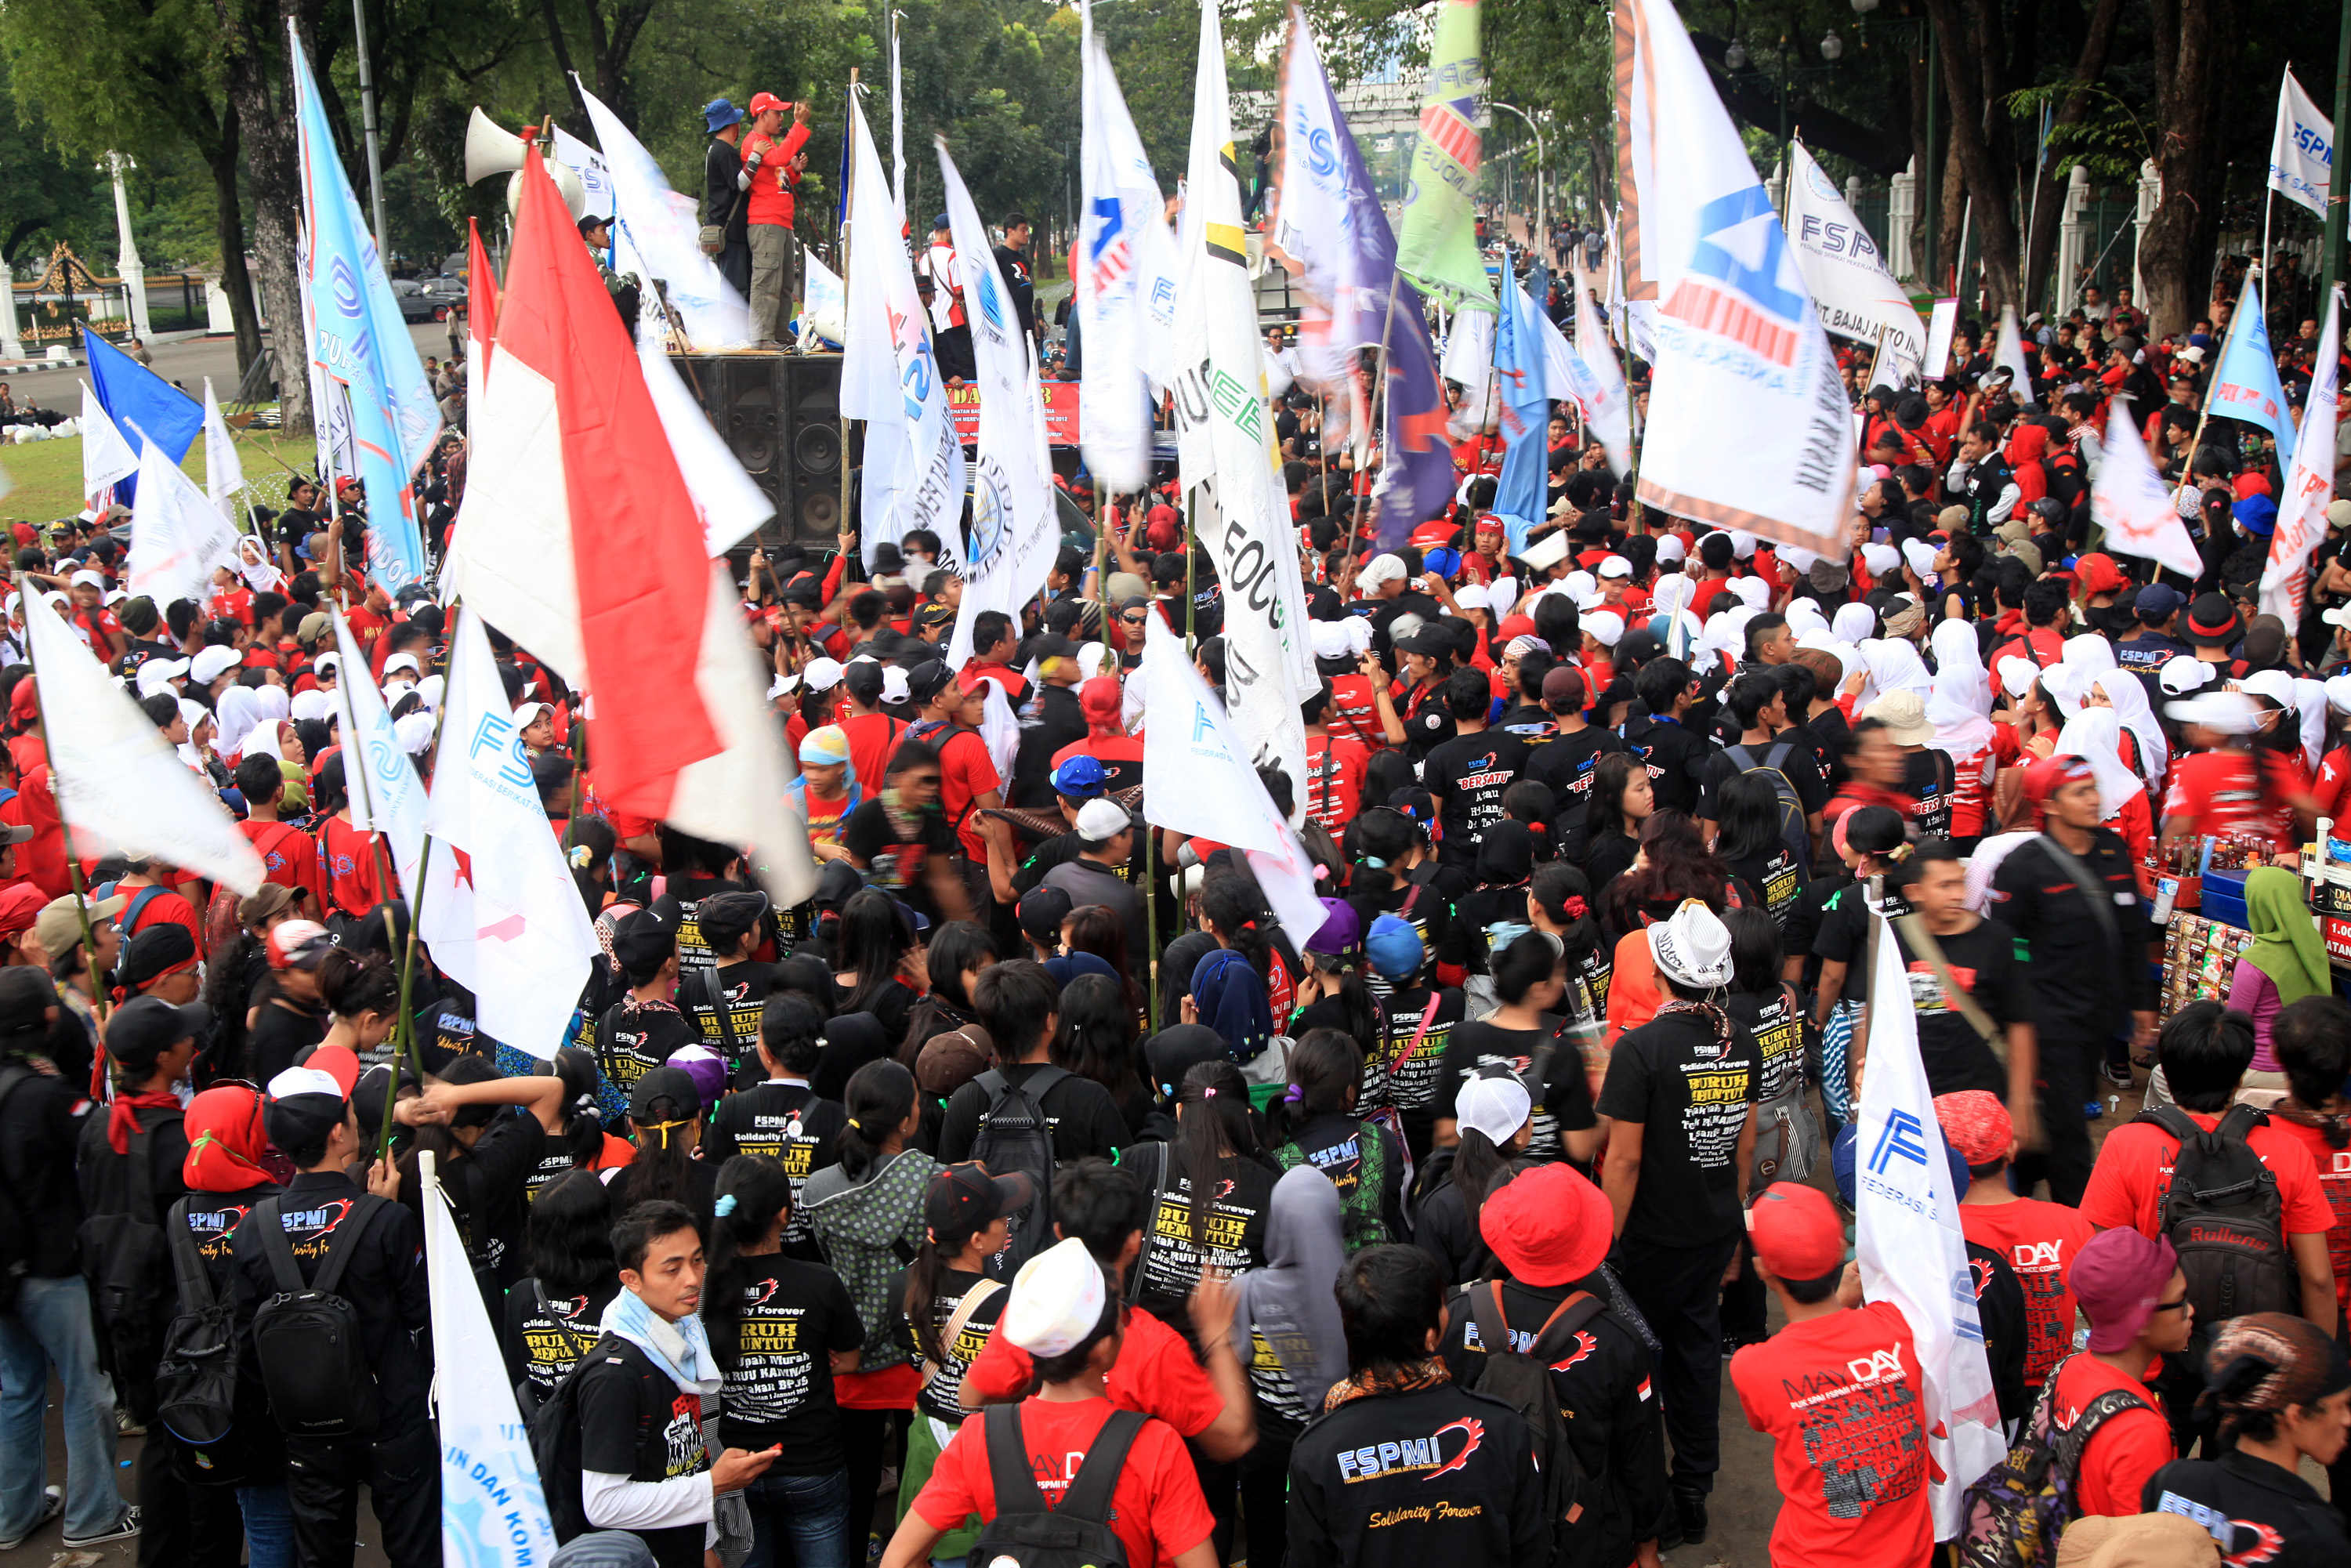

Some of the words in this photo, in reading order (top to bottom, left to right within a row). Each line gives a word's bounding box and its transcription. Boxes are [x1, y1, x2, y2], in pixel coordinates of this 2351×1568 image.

[1833, 311, 1868, 335] BAJAJ
[2121, 650, 2157, 661] FSPMI
[497, 784, 531, 808] SERIKAT
[1476, 790, 1499, 802] Atau
[1759, 1003, 1781, 1016] FSPMI
[1688, 1074, 1749, 1089] BURUH
[734, 1133, 781, 1143] Solidarity
[1860, 1175, 1927, 1215] FEDERASI
[188, 1212, 226, 1227] SPMI
[281, 1210, 328, 1227] SPMI
[2014, 1239, 2063, 1266] DAY
[1144, 1273, 1162, 1282] minan
[757, 1305, 806, 1316] Forever
[741, 1323, 798, 1337] RUH
[740, 1337, 796, 1351] UNTUT
[769, 1352, 810, 1366] Murah
[732, 1370, 757, 1382] RUU
[760, 1362, 812, 1379] KAMNAS
[1782, 1364, 1848, 1400] MAY
[1847, 1342, 1902, 1383] DAY
[777, 1376, 809, 1391] BPJS
[1337, 1436, 1442, 1480] FSPMI
[665, 1464, 684, 1476] MAY
[1032, 1454, 1067, 1479] AY
[1344, 1474, 1365, 1484] FEDERASI
[1365, 1472, 1383, 1481] SERIKAT
[1383, 1468, 1403, 1477] PEKERJA
[1418, 1462, 1442, 1471] INDONESIA
[469, 1462, 512, 1508] DAN
[1037, 1480, 1060, 1489] FSPMI
[1369, 1505, 1431, 1527] Solidarity
[1431, 1501, 1482, 1519] Forever
